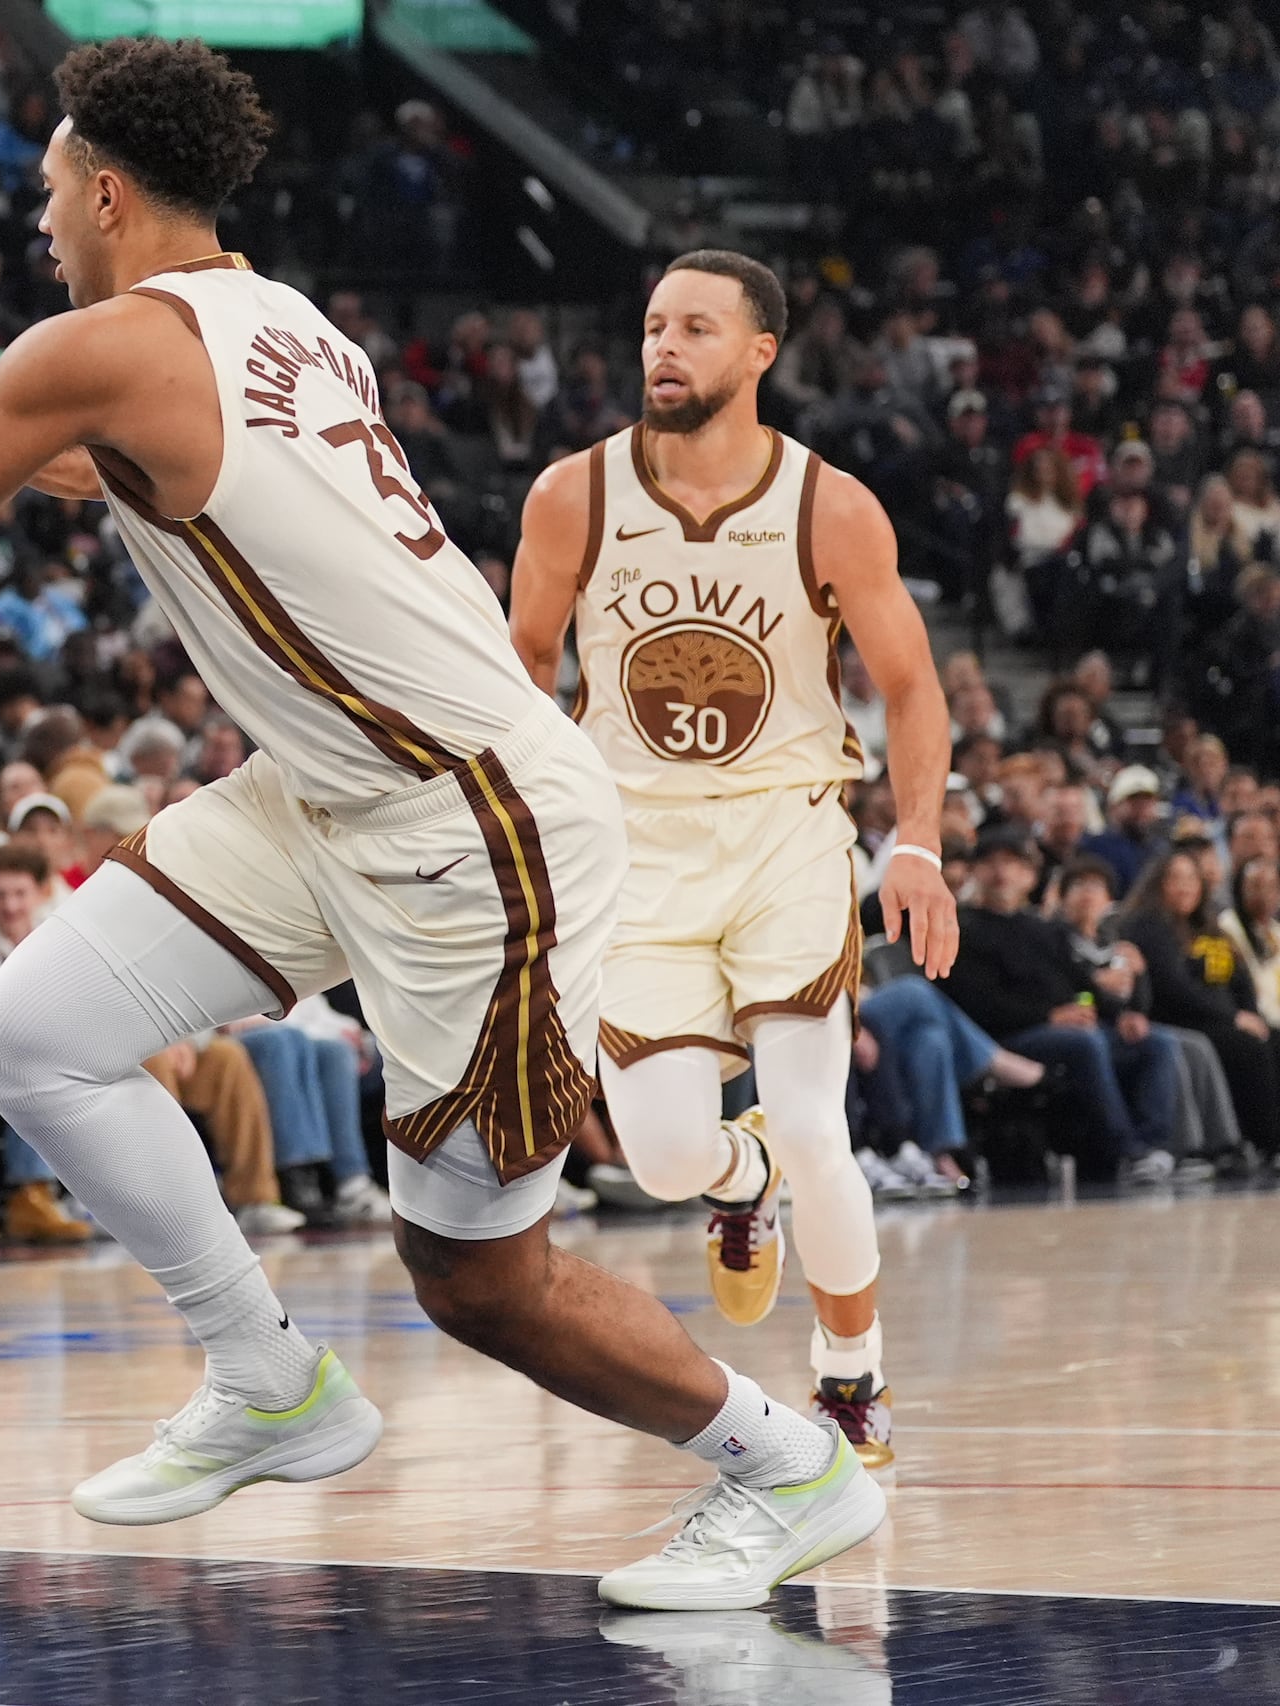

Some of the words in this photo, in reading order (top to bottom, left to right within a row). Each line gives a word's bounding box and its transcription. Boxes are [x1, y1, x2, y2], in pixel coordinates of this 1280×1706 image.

[244, 325, 387, 440] JACKSON-DAVI
[728, 529, 786, 543] Rakuten
[610, 567, 642, 592] The
[604, 574, 785, 642] TOWN
[663, 701, 728, 755] 30
